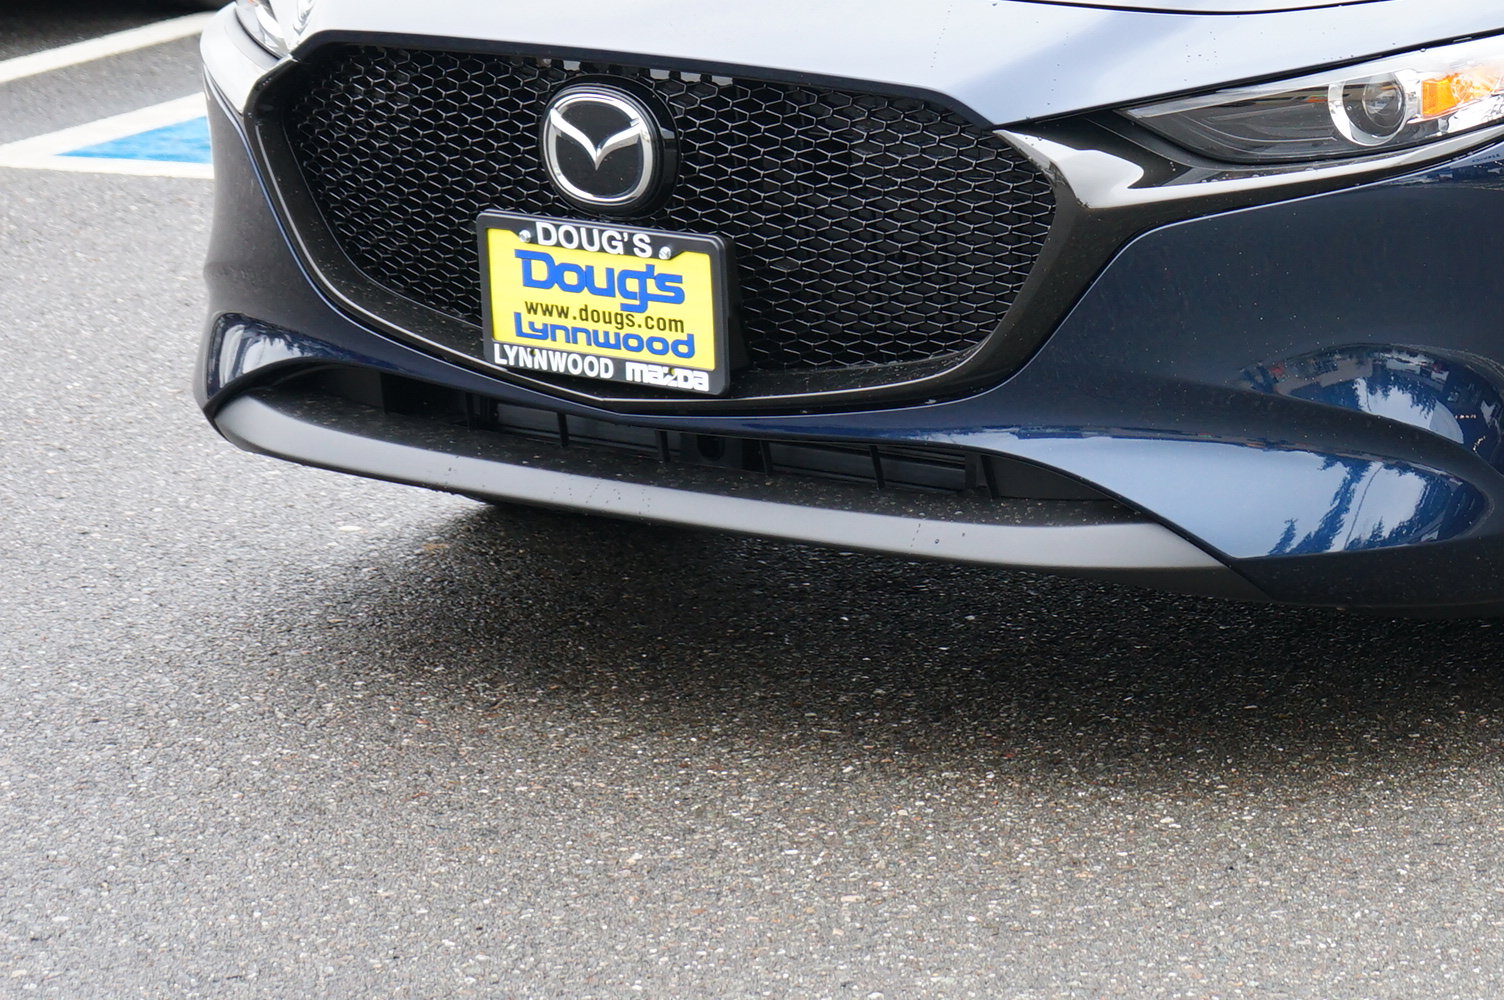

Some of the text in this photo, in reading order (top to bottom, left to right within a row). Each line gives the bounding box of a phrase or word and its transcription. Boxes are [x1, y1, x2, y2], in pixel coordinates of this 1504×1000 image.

[535, 221, 653, 259] DOUG'S
[514, 249, 686, 313] Doug's
[514, 311, 696, 359] Lynnwood
[524, 301, 685, 333] www.dougs.com
[493, 343, 614, 379] LYNNWOOD
